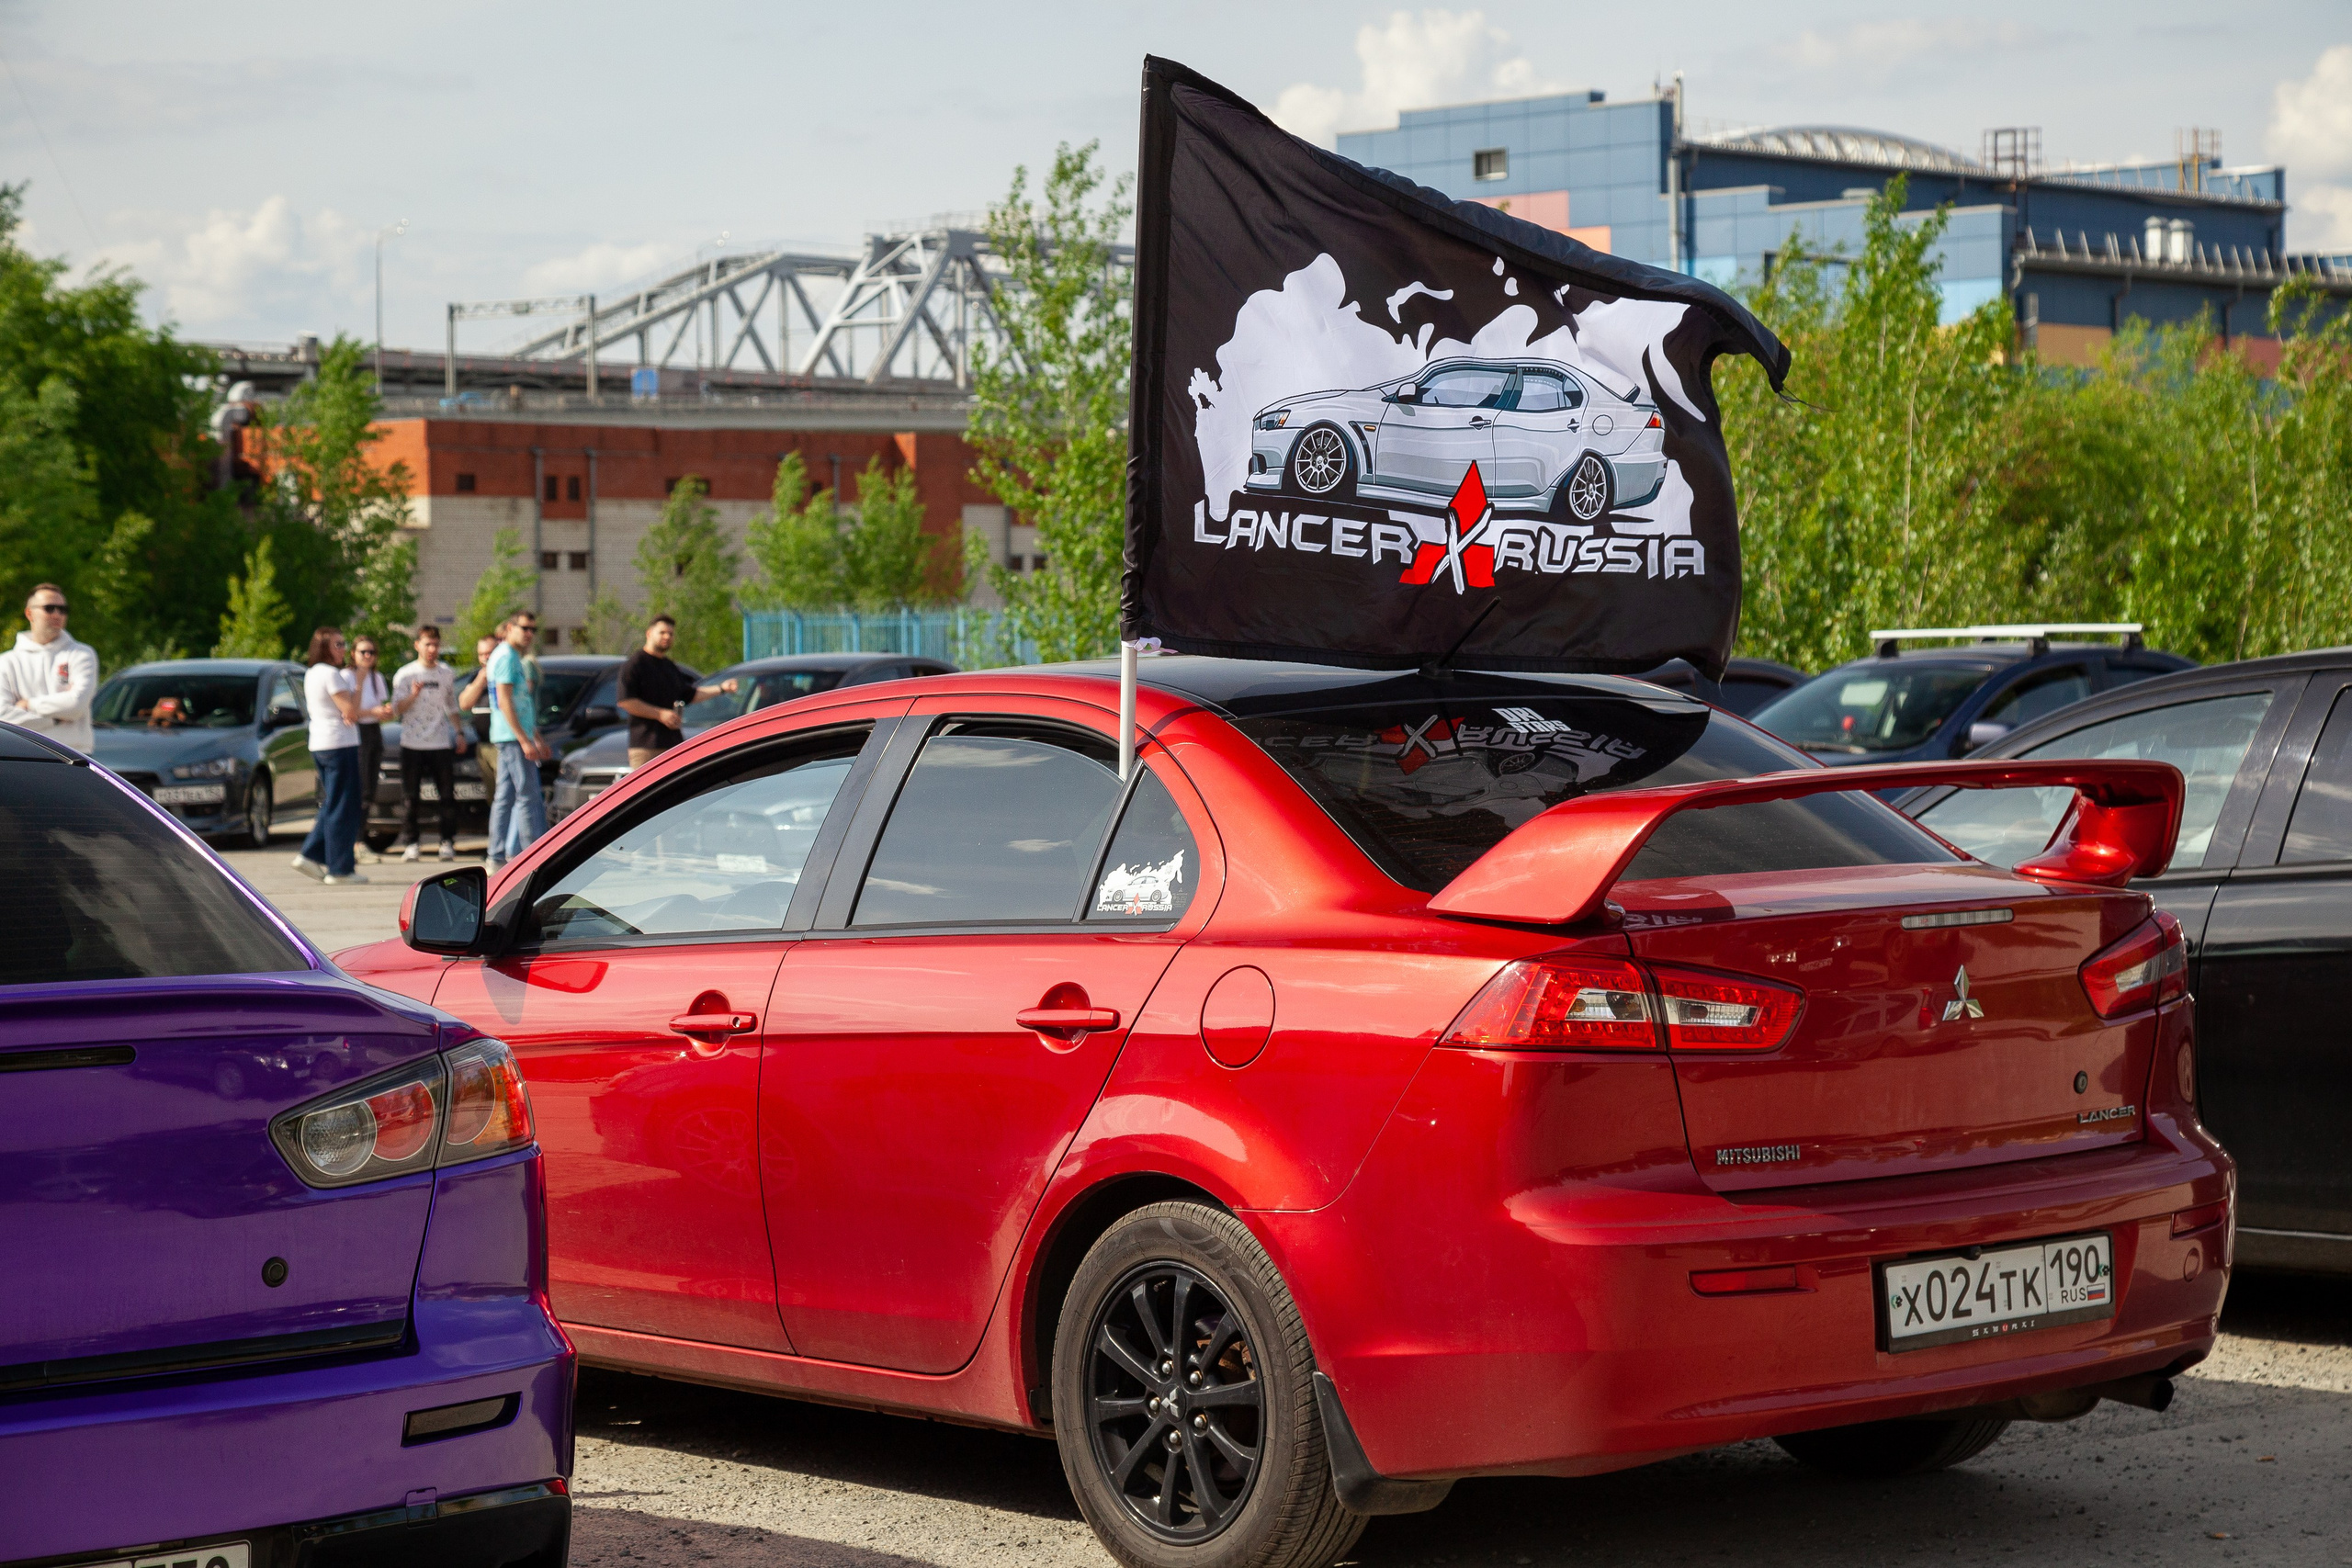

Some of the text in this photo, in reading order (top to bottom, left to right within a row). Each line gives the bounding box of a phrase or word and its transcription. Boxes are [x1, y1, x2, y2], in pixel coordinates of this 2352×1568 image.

[1194, 500, 1415, 565] LANCER
[1495, 526, 1706, 581] RUSSIA
[1491, 706, 1545, 722] DRI
[1507, 719, 1572, 734] STARS
[1141, 903, 1173, 912] RUSSIA
[2077, 1105, 2136, 1124] LANCER
[1716, 1145, 1801, 1166] MITSUBISHI
[2050, 1244, 2100, 1289] 190
[2061, 1287, 2086, 1304] RUS
